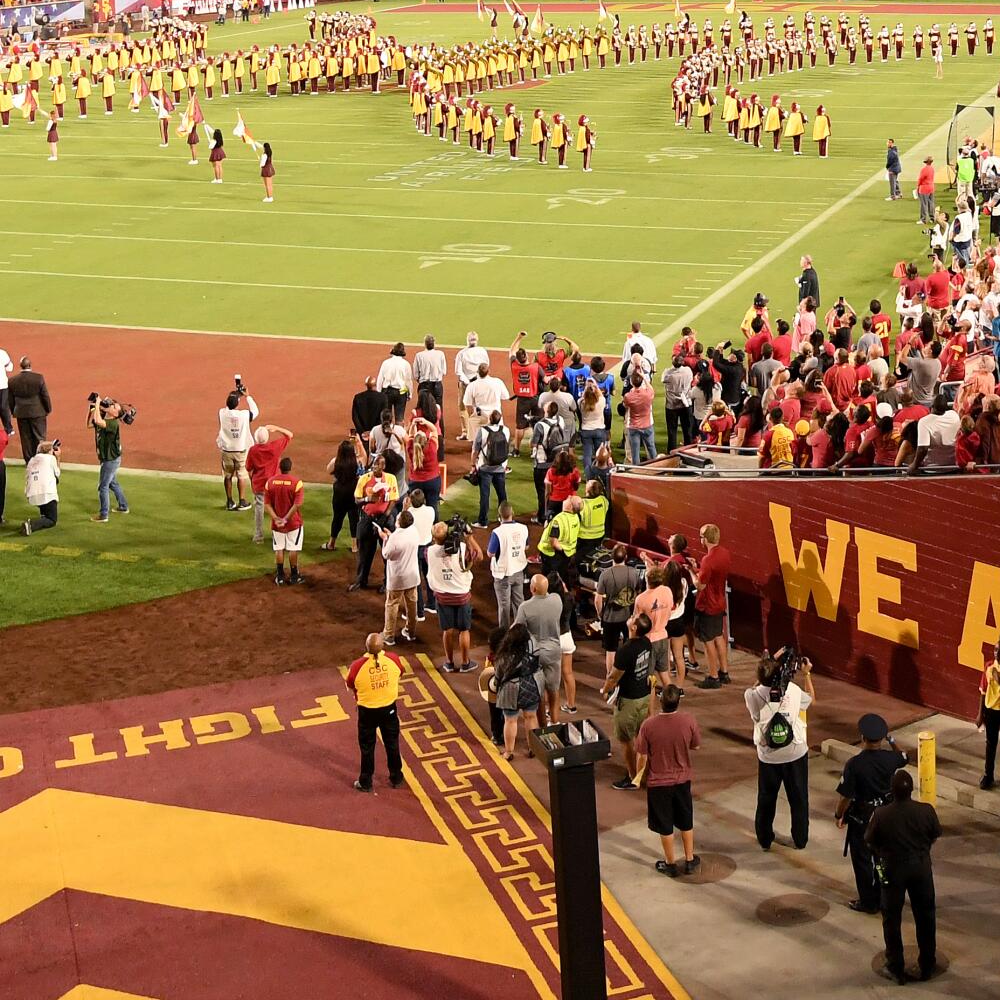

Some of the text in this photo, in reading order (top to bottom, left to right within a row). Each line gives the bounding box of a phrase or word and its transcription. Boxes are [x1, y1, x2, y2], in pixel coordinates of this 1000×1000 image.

[875, 321, 889, 339] 21
[778, 436, 791, 444] CSC
[769, 501, 919, 649] WE
[369, 664, 388, 674] CSC
[371, 680, 389, 690] STAFF
[55, 695, 350, 768] FIGHT
